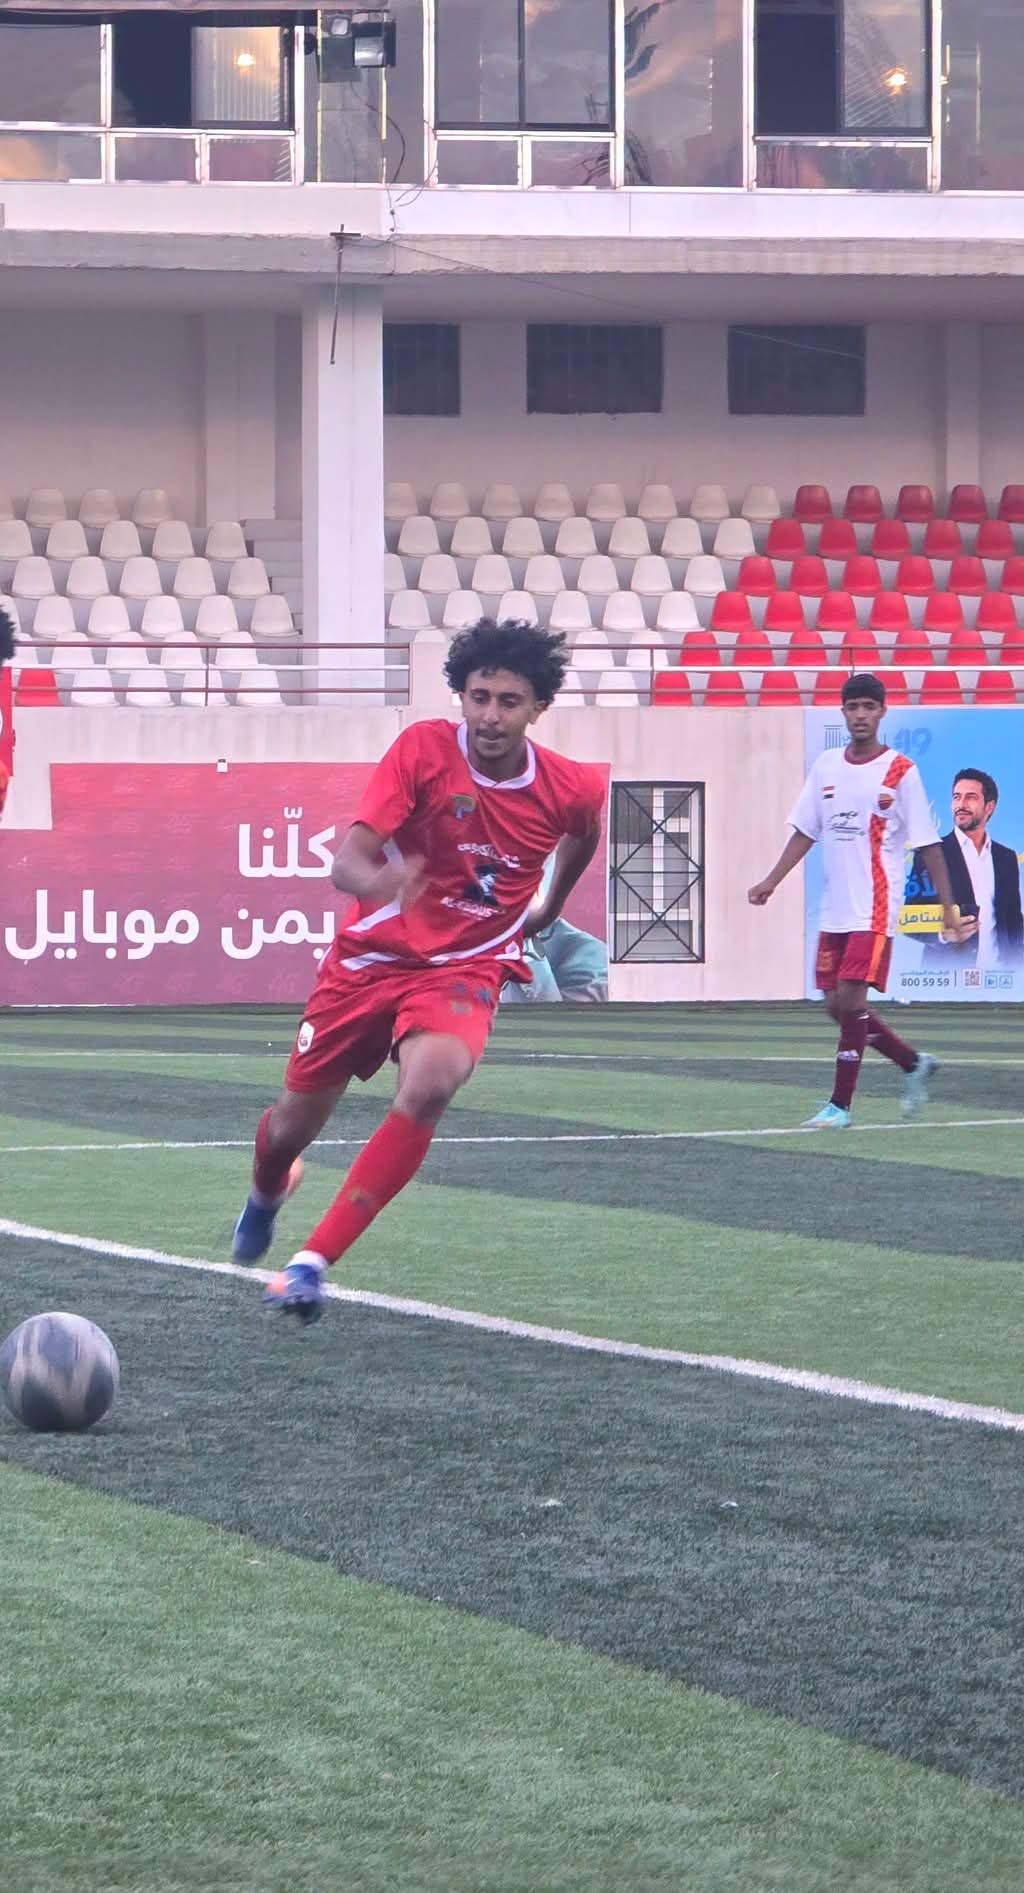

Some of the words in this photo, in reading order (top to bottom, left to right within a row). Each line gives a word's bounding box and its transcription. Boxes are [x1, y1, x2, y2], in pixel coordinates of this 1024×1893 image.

[5, 889, 200, 960] موبايل
[901, 977, 920, 987] 800
[923, 977, 936, 987] 59
[938, 977, 950, 987] 59
